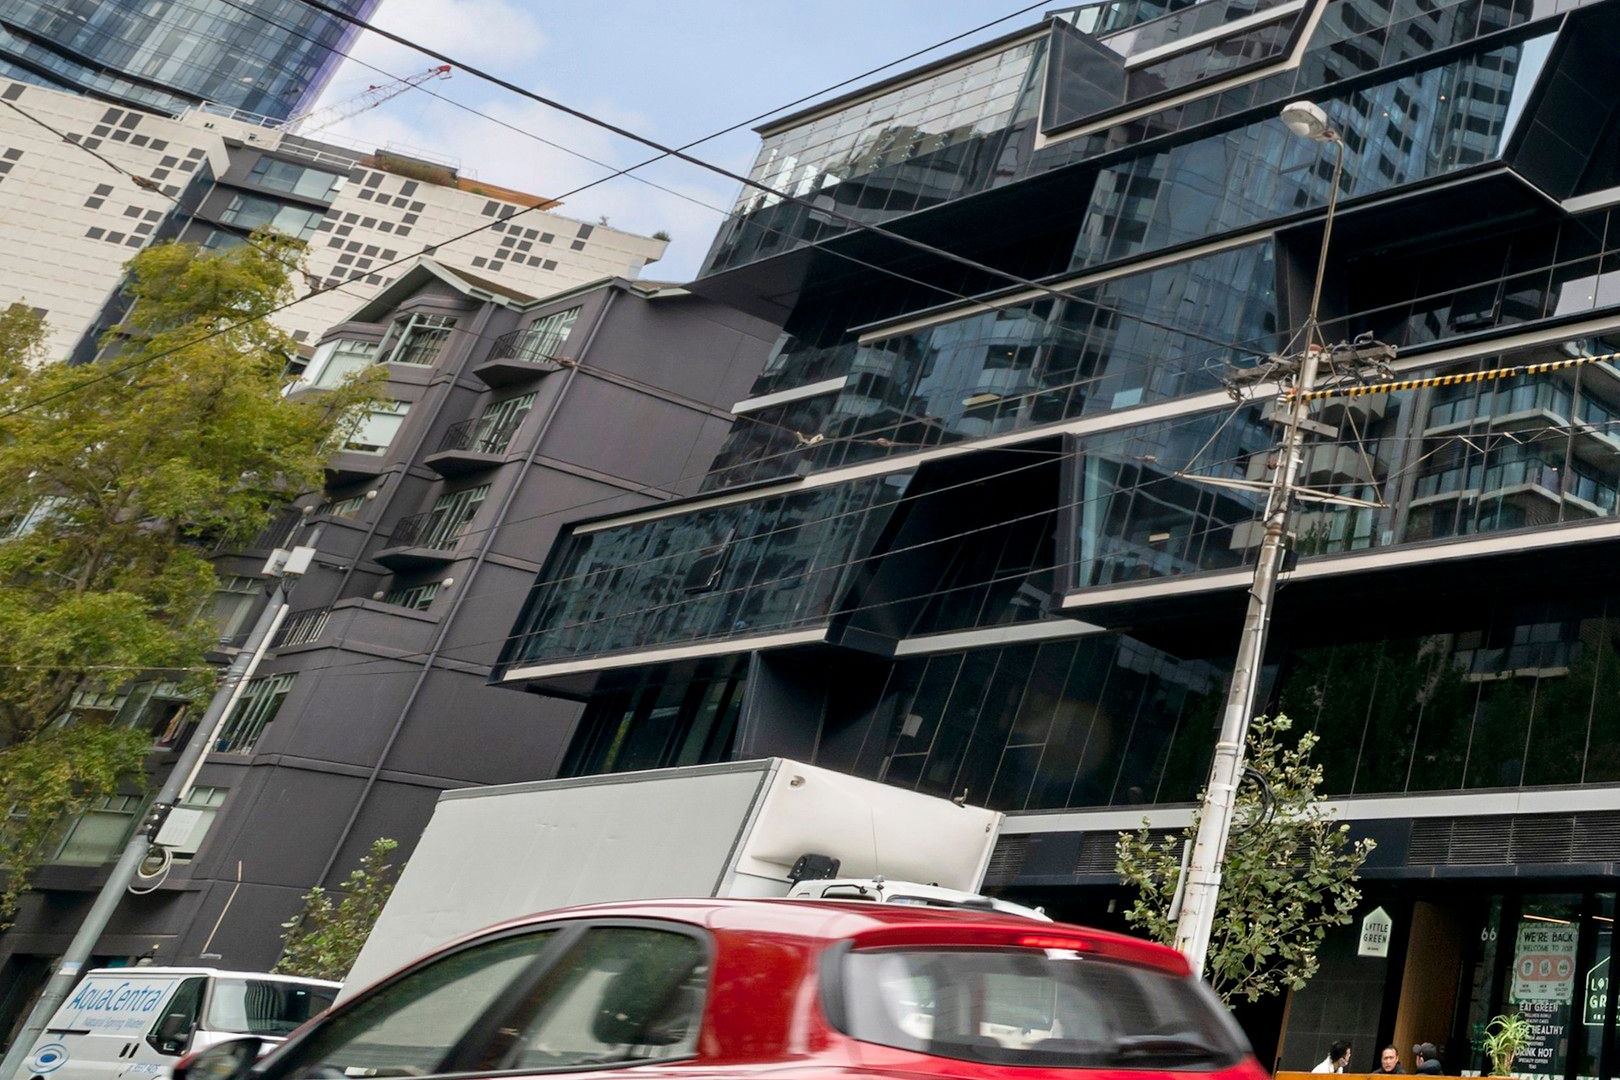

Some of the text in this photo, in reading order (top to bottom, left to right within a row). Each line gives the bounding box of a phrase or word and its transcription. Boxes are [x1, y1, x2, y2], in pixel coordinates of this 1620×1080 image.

[1363, 933, 1387, 943] GREEN
[1481, 927, 1496, 941] 66
[1523, 932, 1574, 942] WE'RE BACK
[67, 980, 174, 1013] AquaCentral
[1519, 1002, 1559, 1012] EAT GREEN
[1531, 1025, 1564, 1035] HEALTHY
[1537, 1048, 1553, 1058] HOT
